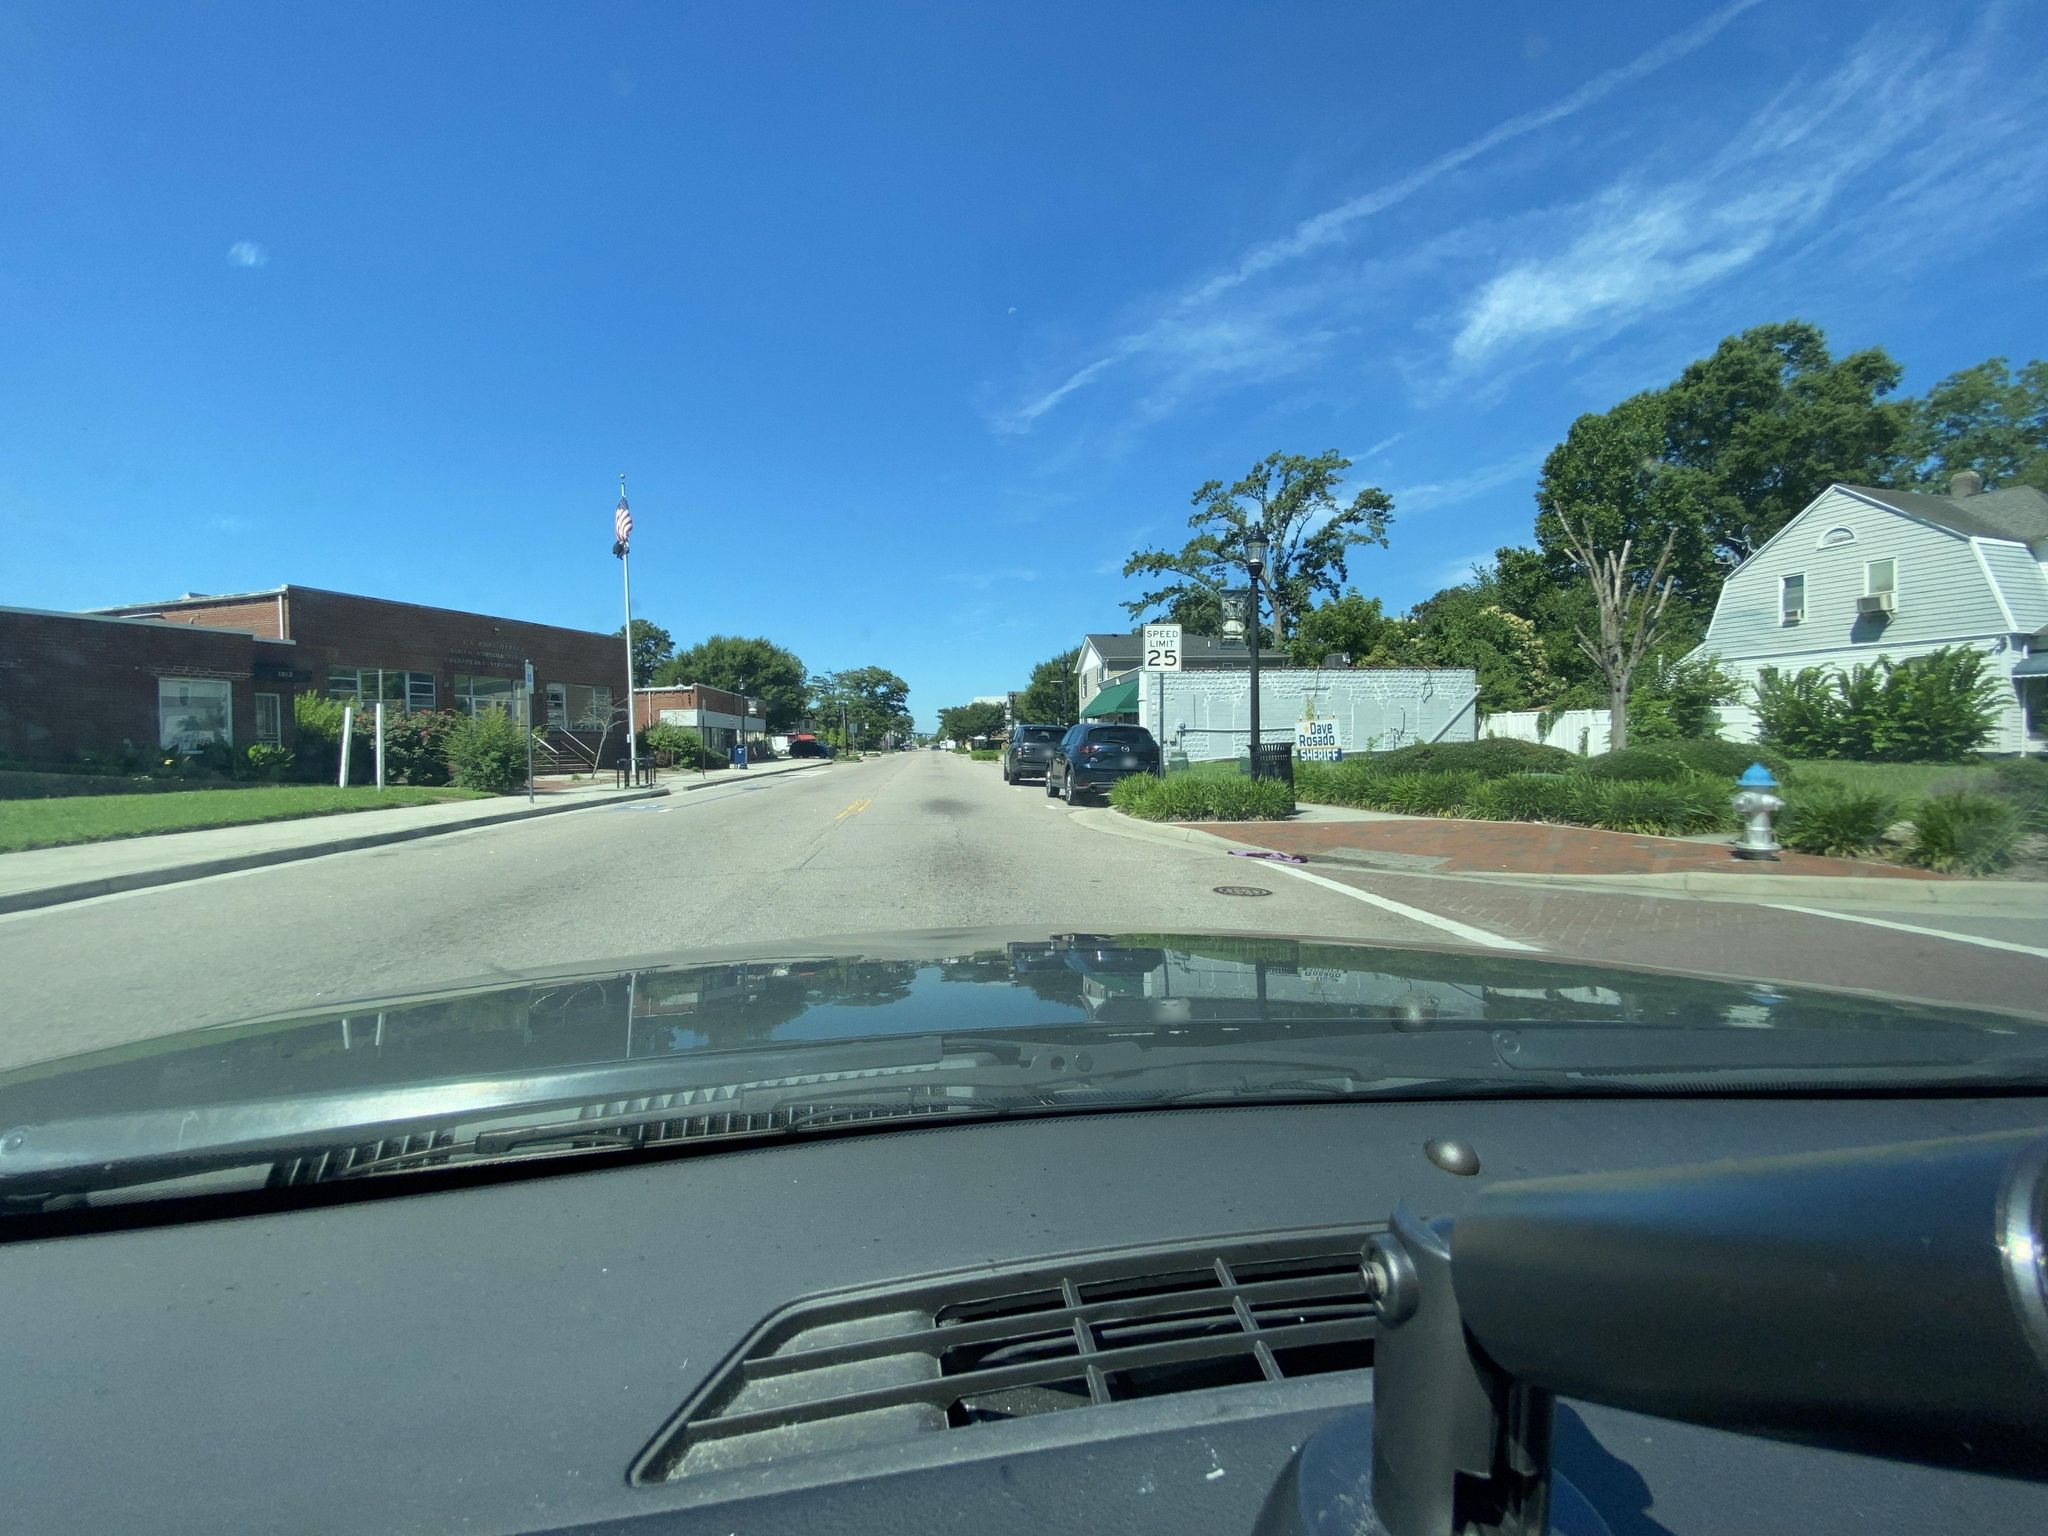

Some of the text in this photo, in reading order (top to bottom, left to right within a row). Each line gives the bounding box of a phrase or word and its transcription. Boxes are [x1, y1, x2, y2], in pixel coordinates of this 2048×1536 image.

[1146, 630, 1179, 638] SPEED
[1149, 640, 1174, 648] LIMIT
[1148, 650, 1177, 667] 25
[1310, 722, 1333, 735] Dave
[1299, 733, 1335, 746] Rosado
[1300, 748, 1339, 761] SHERIFF
